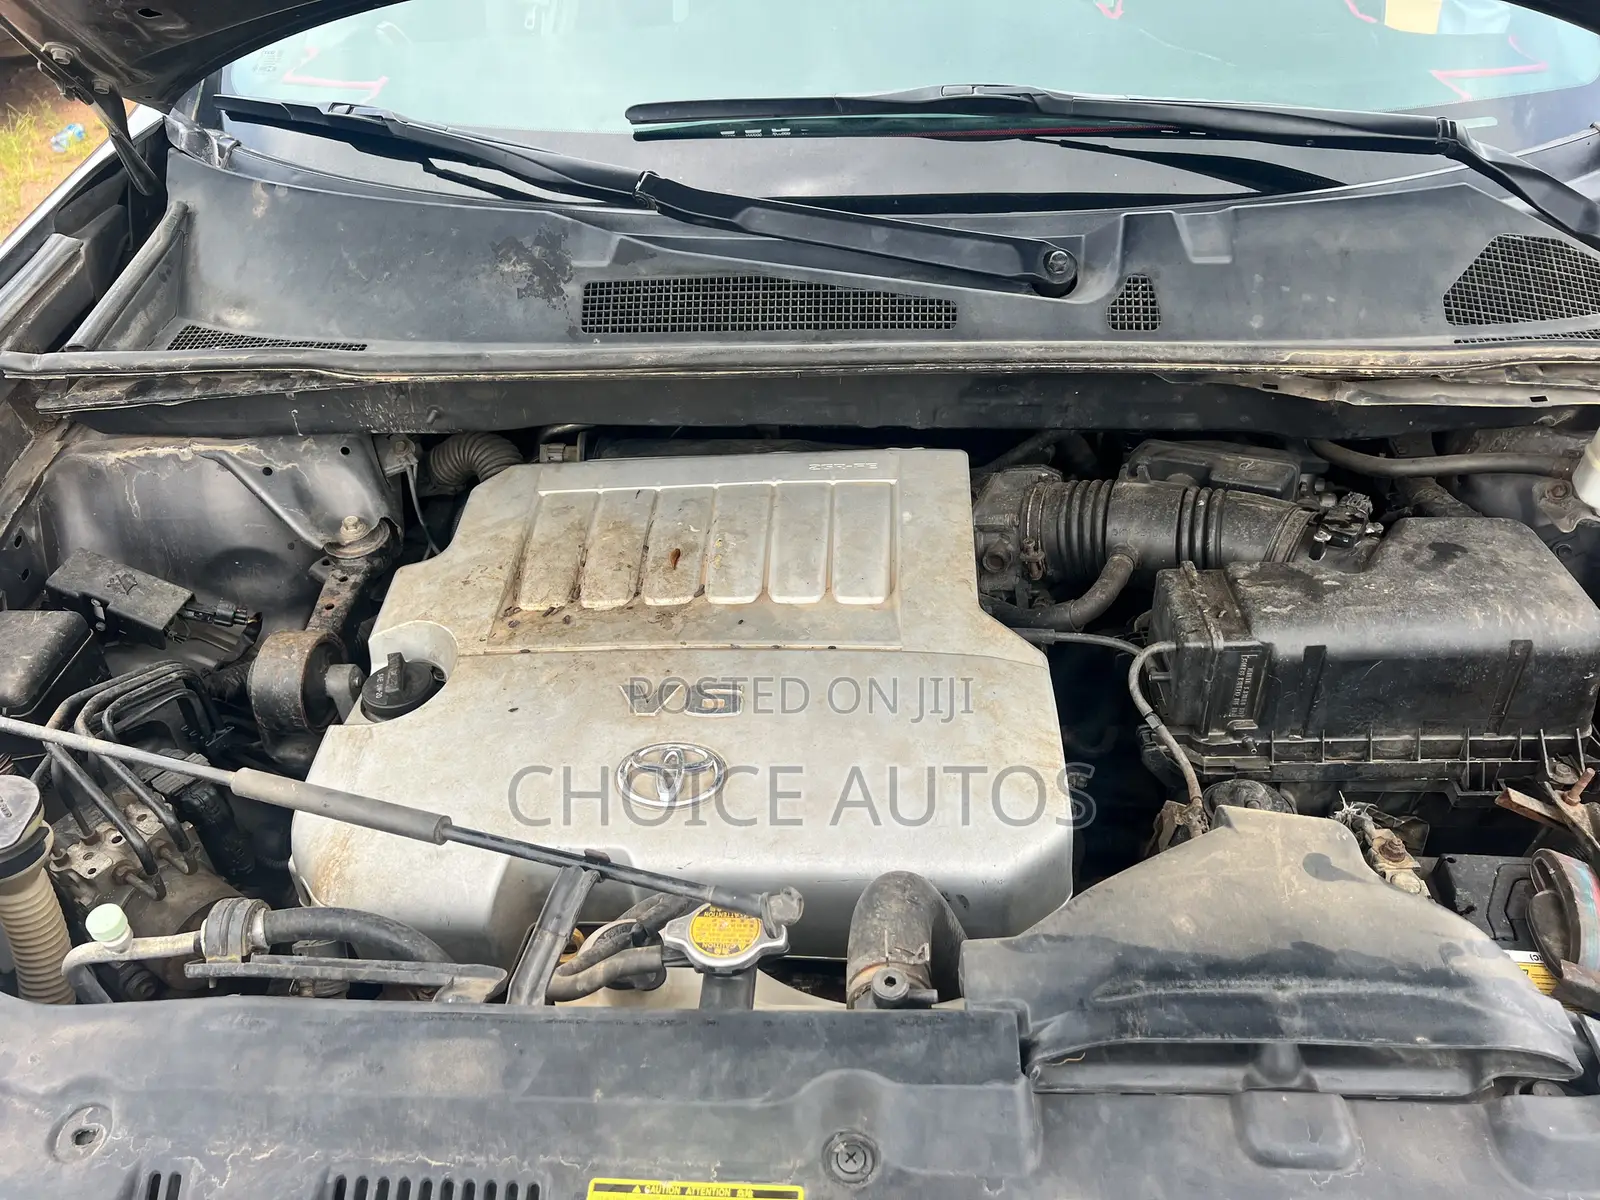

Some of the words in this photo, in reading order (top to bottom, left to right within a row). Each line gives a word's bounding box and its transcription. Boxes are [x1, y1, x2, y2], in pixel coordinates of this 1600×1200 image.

[618, 683, 745, 718] V6
[644, 1184, 681, 1195] CAUTION
[685, 1186, 731, 1197] ATTENTION
